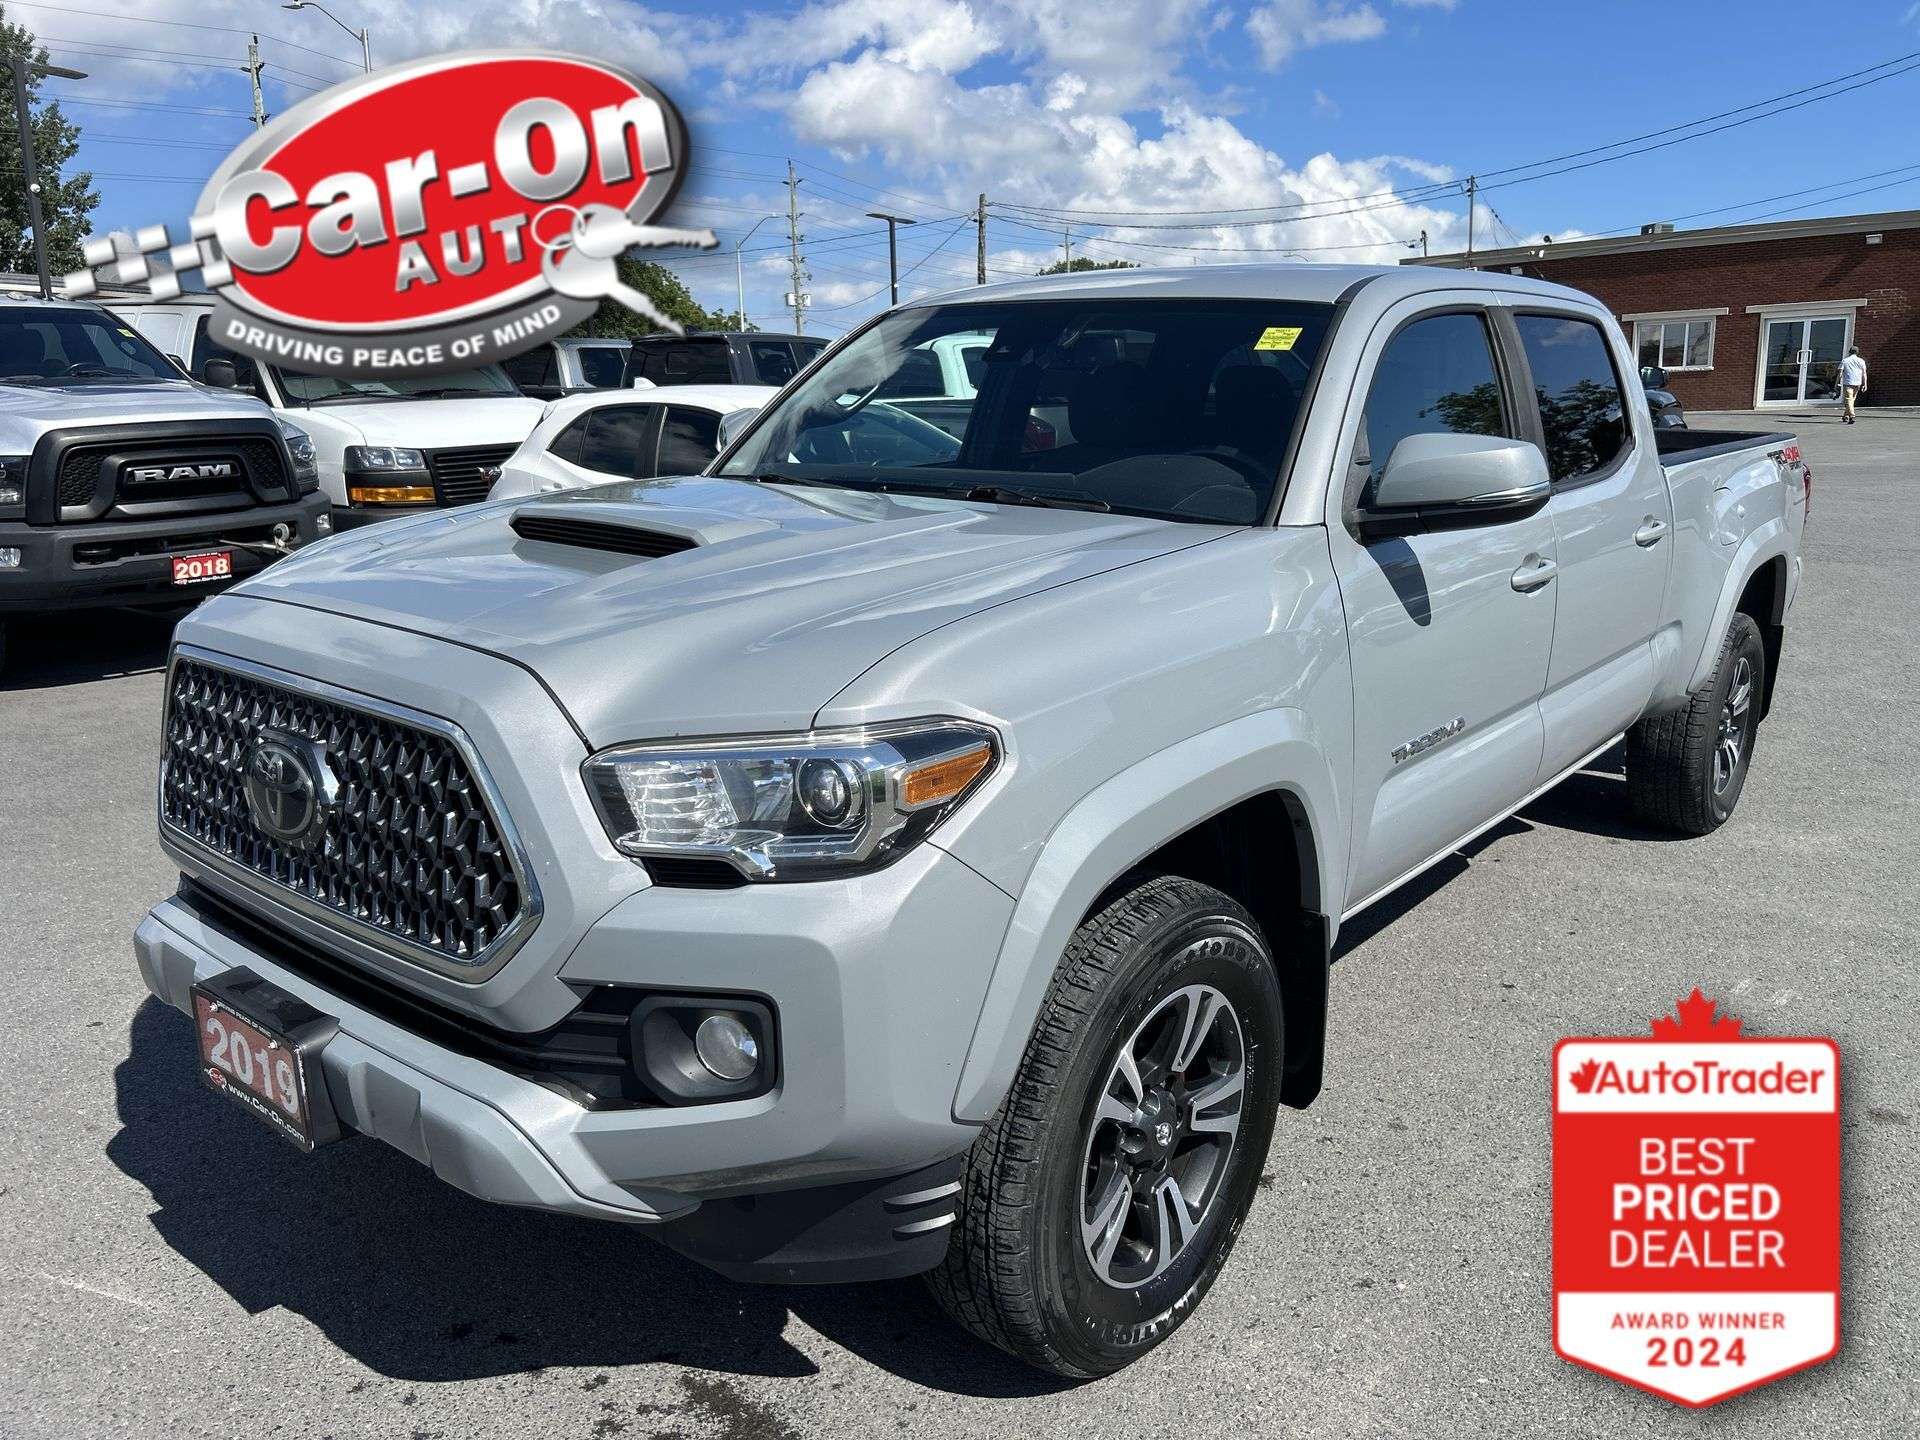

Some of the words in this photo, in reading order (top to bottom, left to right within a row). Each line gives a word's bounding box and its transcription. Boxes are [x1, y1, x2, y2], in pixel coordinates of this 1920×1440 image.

[133, 464, 231, 482] RAM
[175, 558, 228, 579] 2018
[206, 1017, 299, 1114] 2019
[227, 1083, 306, 1144] www.Car-On.com
